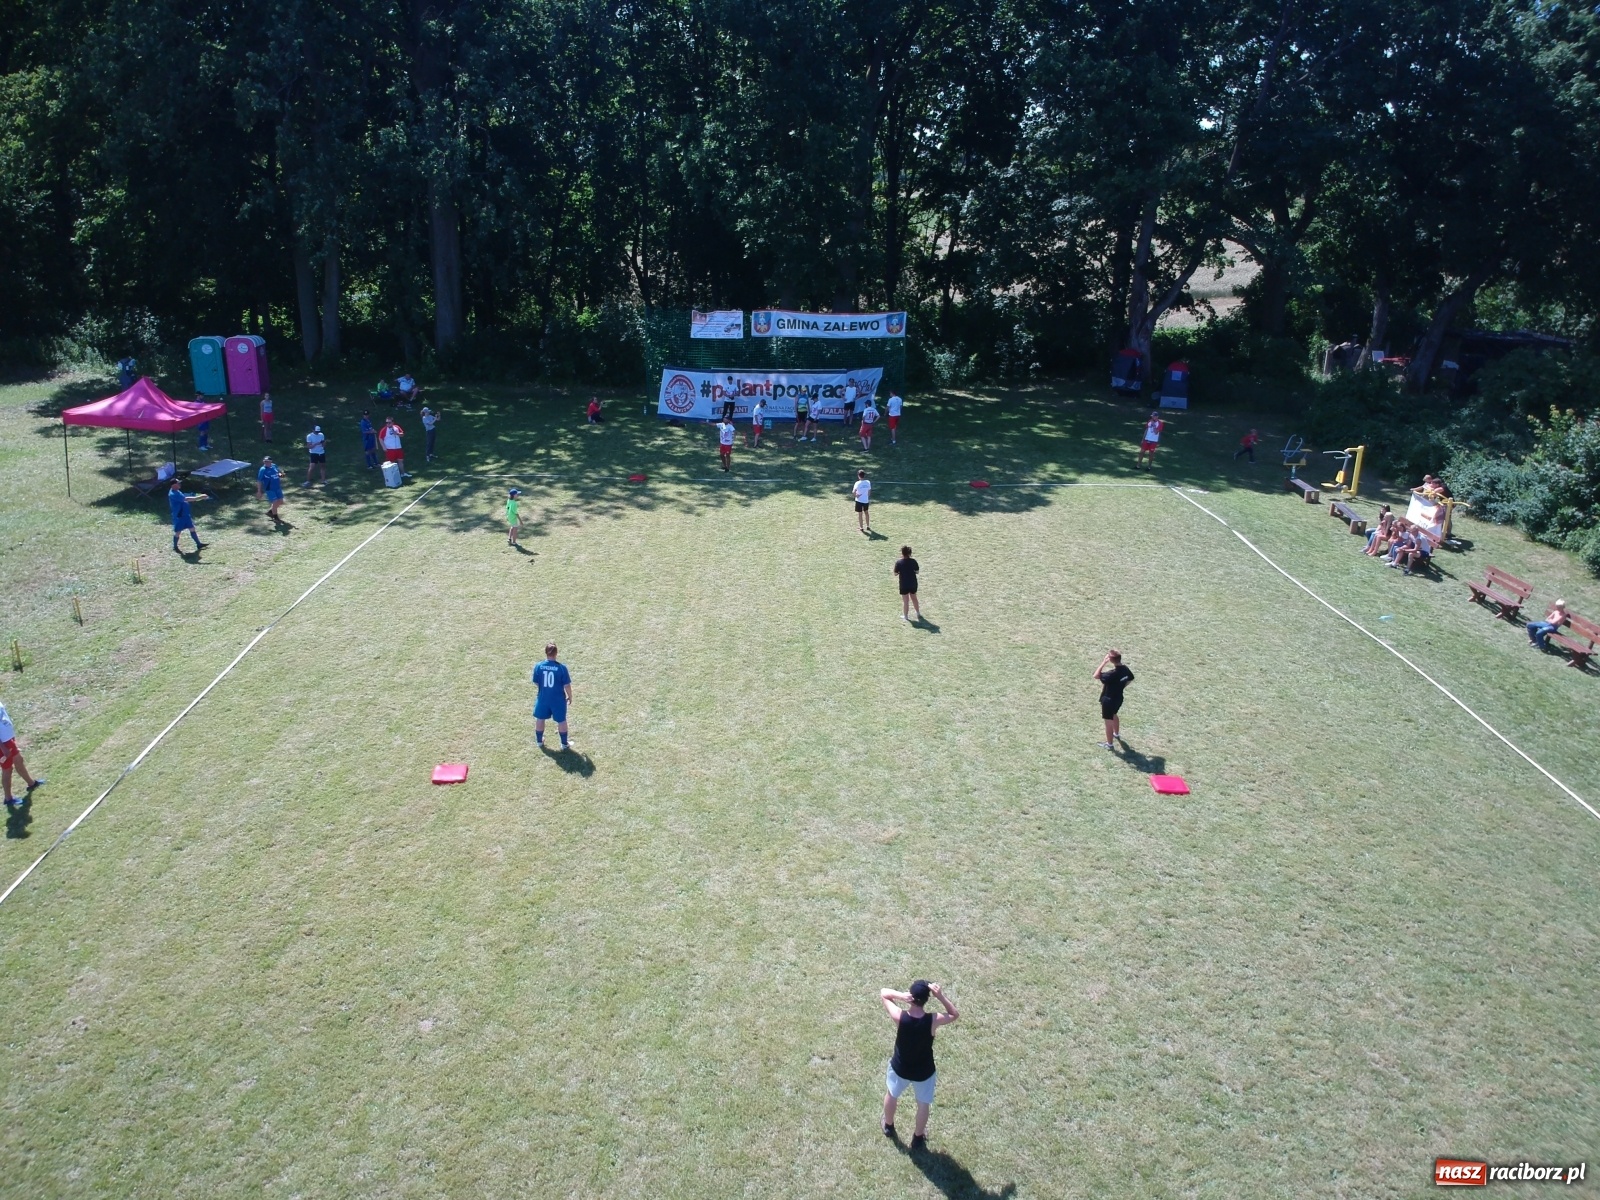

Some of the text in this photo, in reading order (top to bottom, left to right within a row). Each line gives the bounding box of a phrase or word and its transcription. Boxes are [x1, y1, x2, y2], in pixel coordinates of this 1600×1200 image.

[776, 318, 880, 332] GMINA ZALEWO
[700, 378, 848, 403] #plantpowrac
[543, 671, 554, 687] 10
